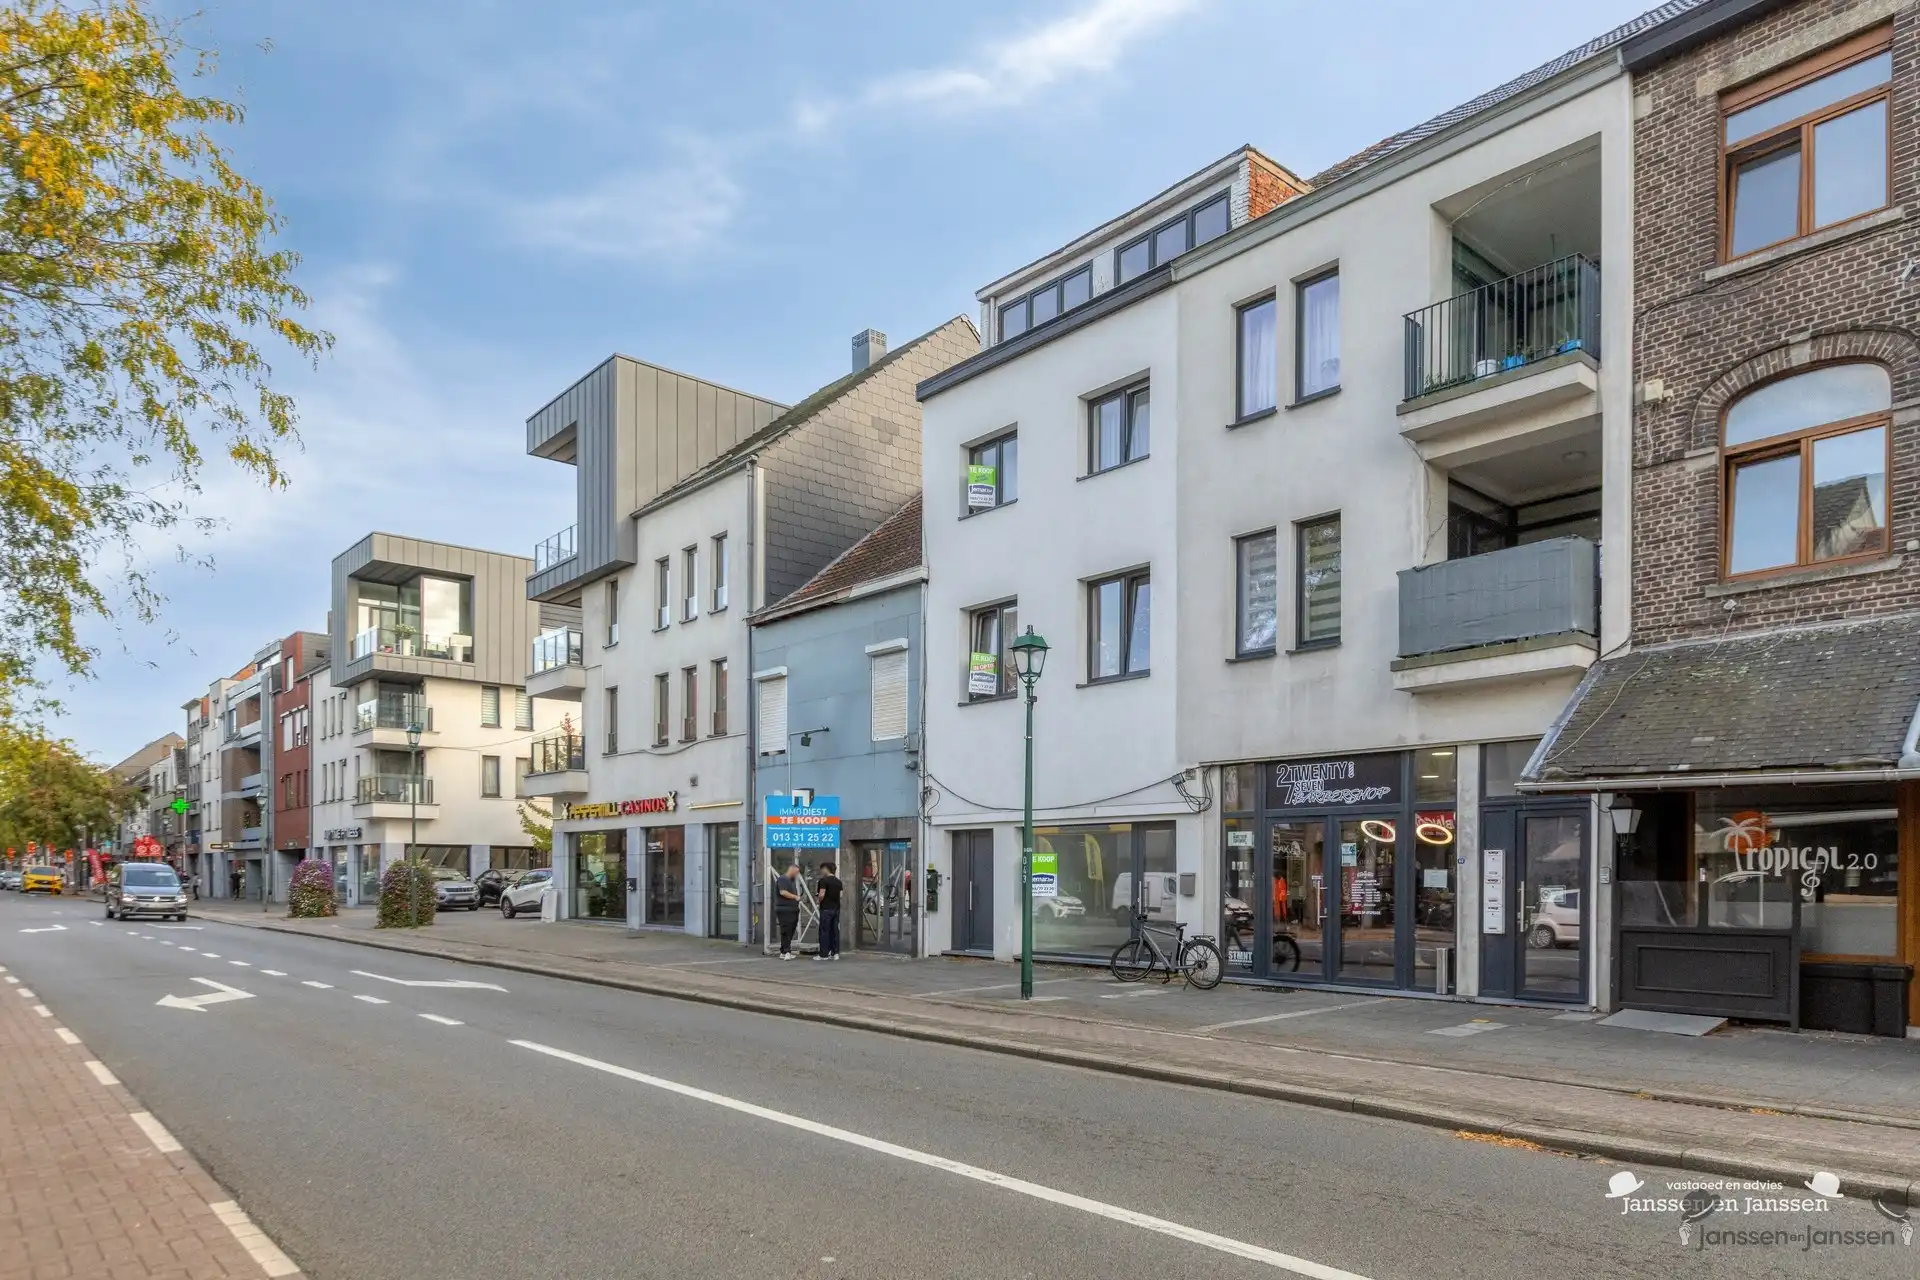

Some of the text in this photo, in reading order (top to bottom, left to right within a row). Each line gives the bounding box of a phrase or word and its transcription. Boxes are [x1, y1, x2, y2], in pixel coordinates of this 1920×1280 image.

[1289, 761, 1348, 780] TWENTY
[1294, 780, 1325, 793] SEVEN
[1292, 786, 1392, 805] BARBERSHOP
[570, 797, 668, 820] PEPPERMILL CASINOS
[780, 816, 828, 824] TE KOOP
[772, 833, 834, 842] 013 31 25 22
[1847, 853, 1878, 870] 2.0
[1228, 950, 1253, 961] STMNT
